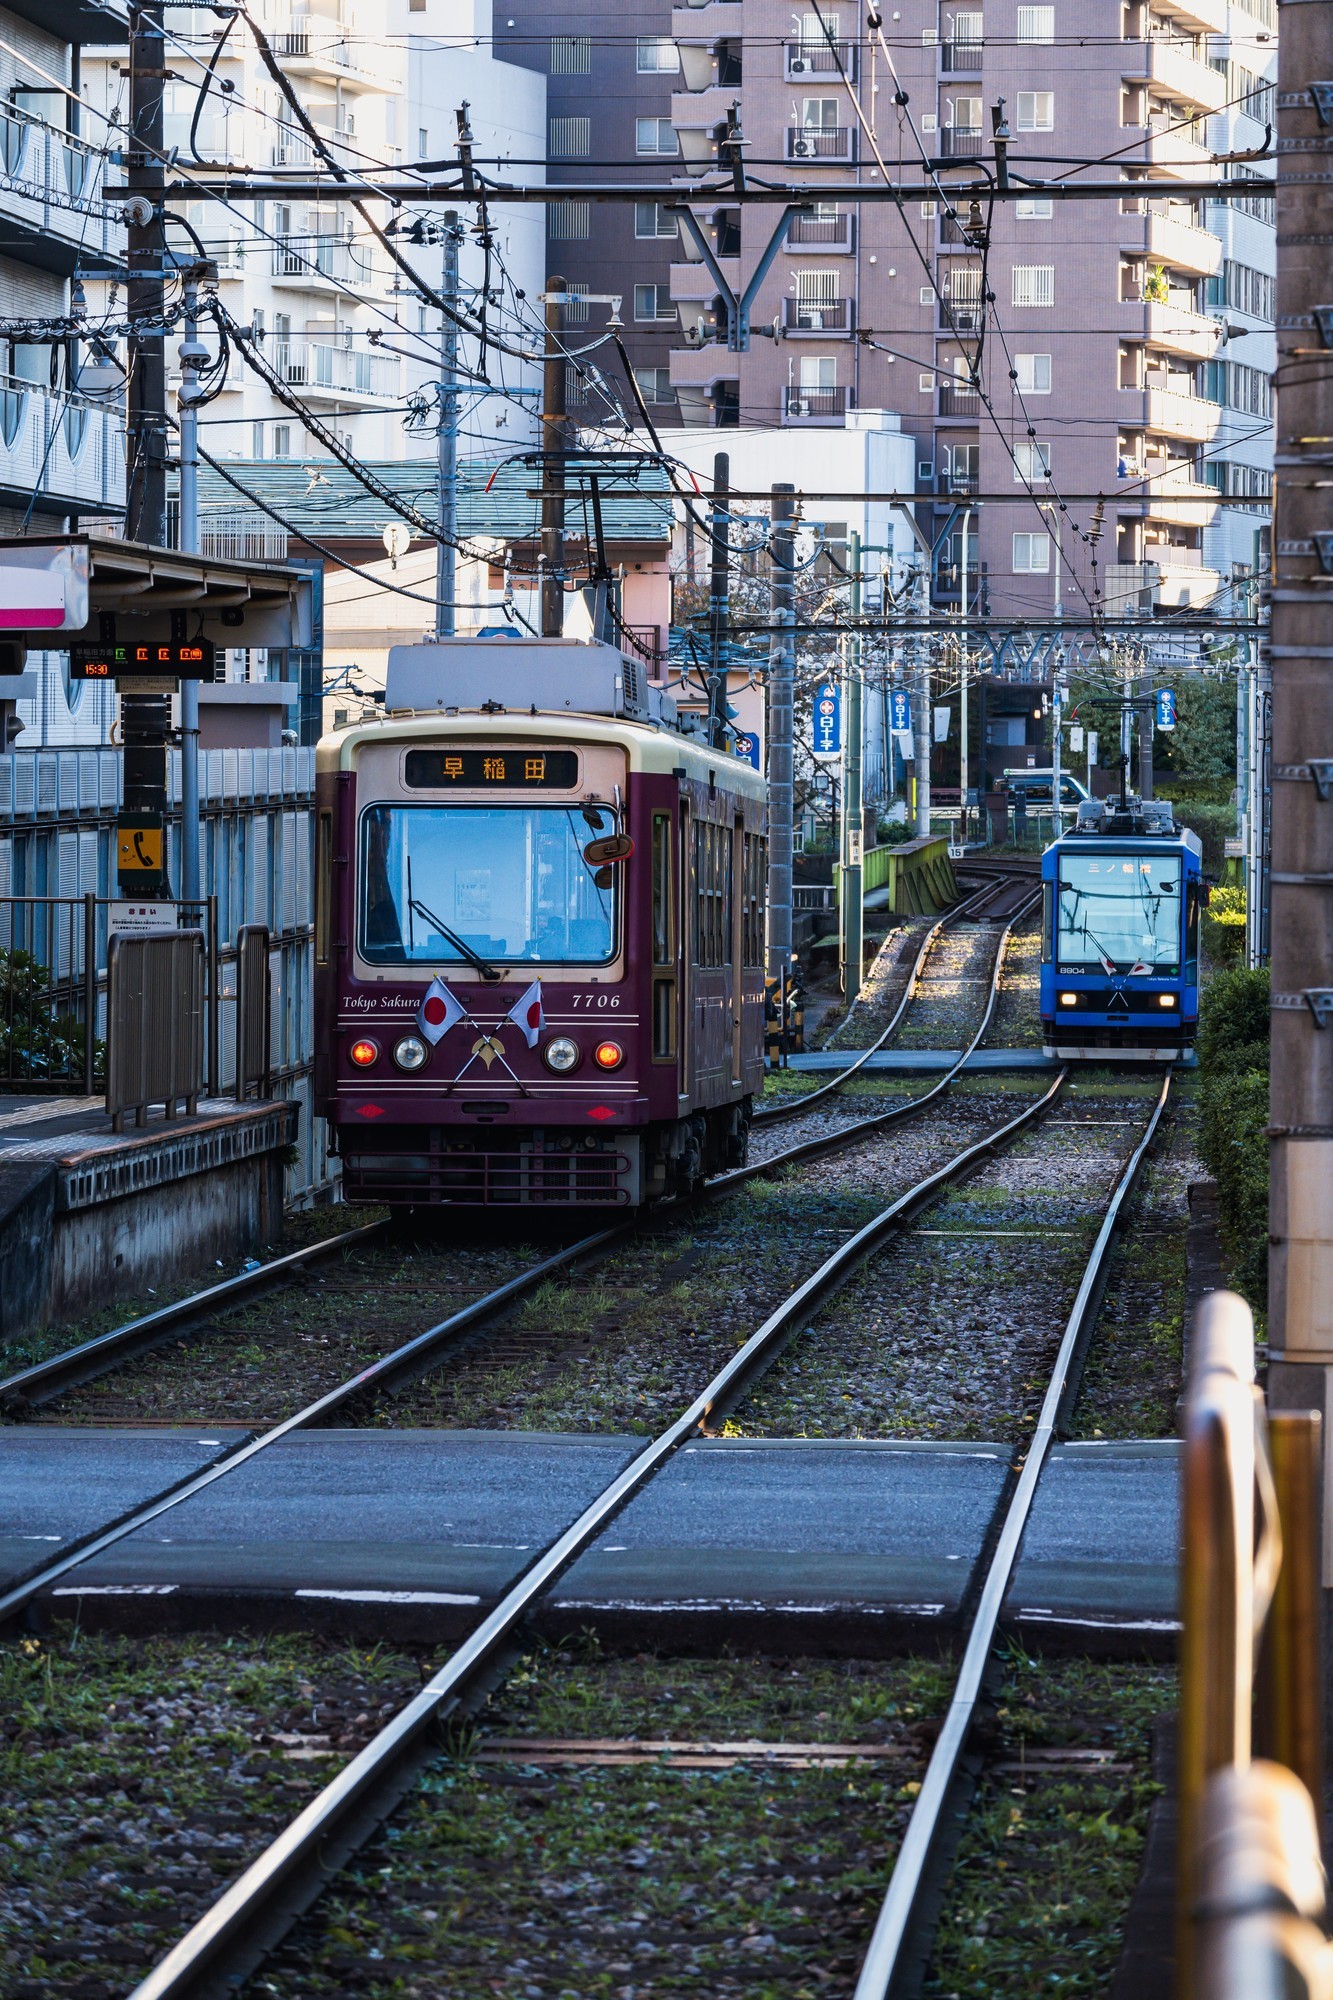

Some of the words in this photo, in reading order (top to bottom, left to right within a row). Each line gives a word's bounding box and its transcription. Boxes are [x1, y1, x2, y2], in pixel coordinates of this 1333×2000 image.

[85, 664, 108, 675] 15:30
[895, 705, 905, 729] 白十字
[820, 716, 833, 751] 白十字
[443, 757, 544, 779] 早稲田
[951, 849, 962, 857] 15
[1060, 967, 1085, 975] 8904
[343, 995, 377, 1012] Tokyo
[380, 995, 420, 1008] Sakura
[572, 995, 620, 1008] 7706
